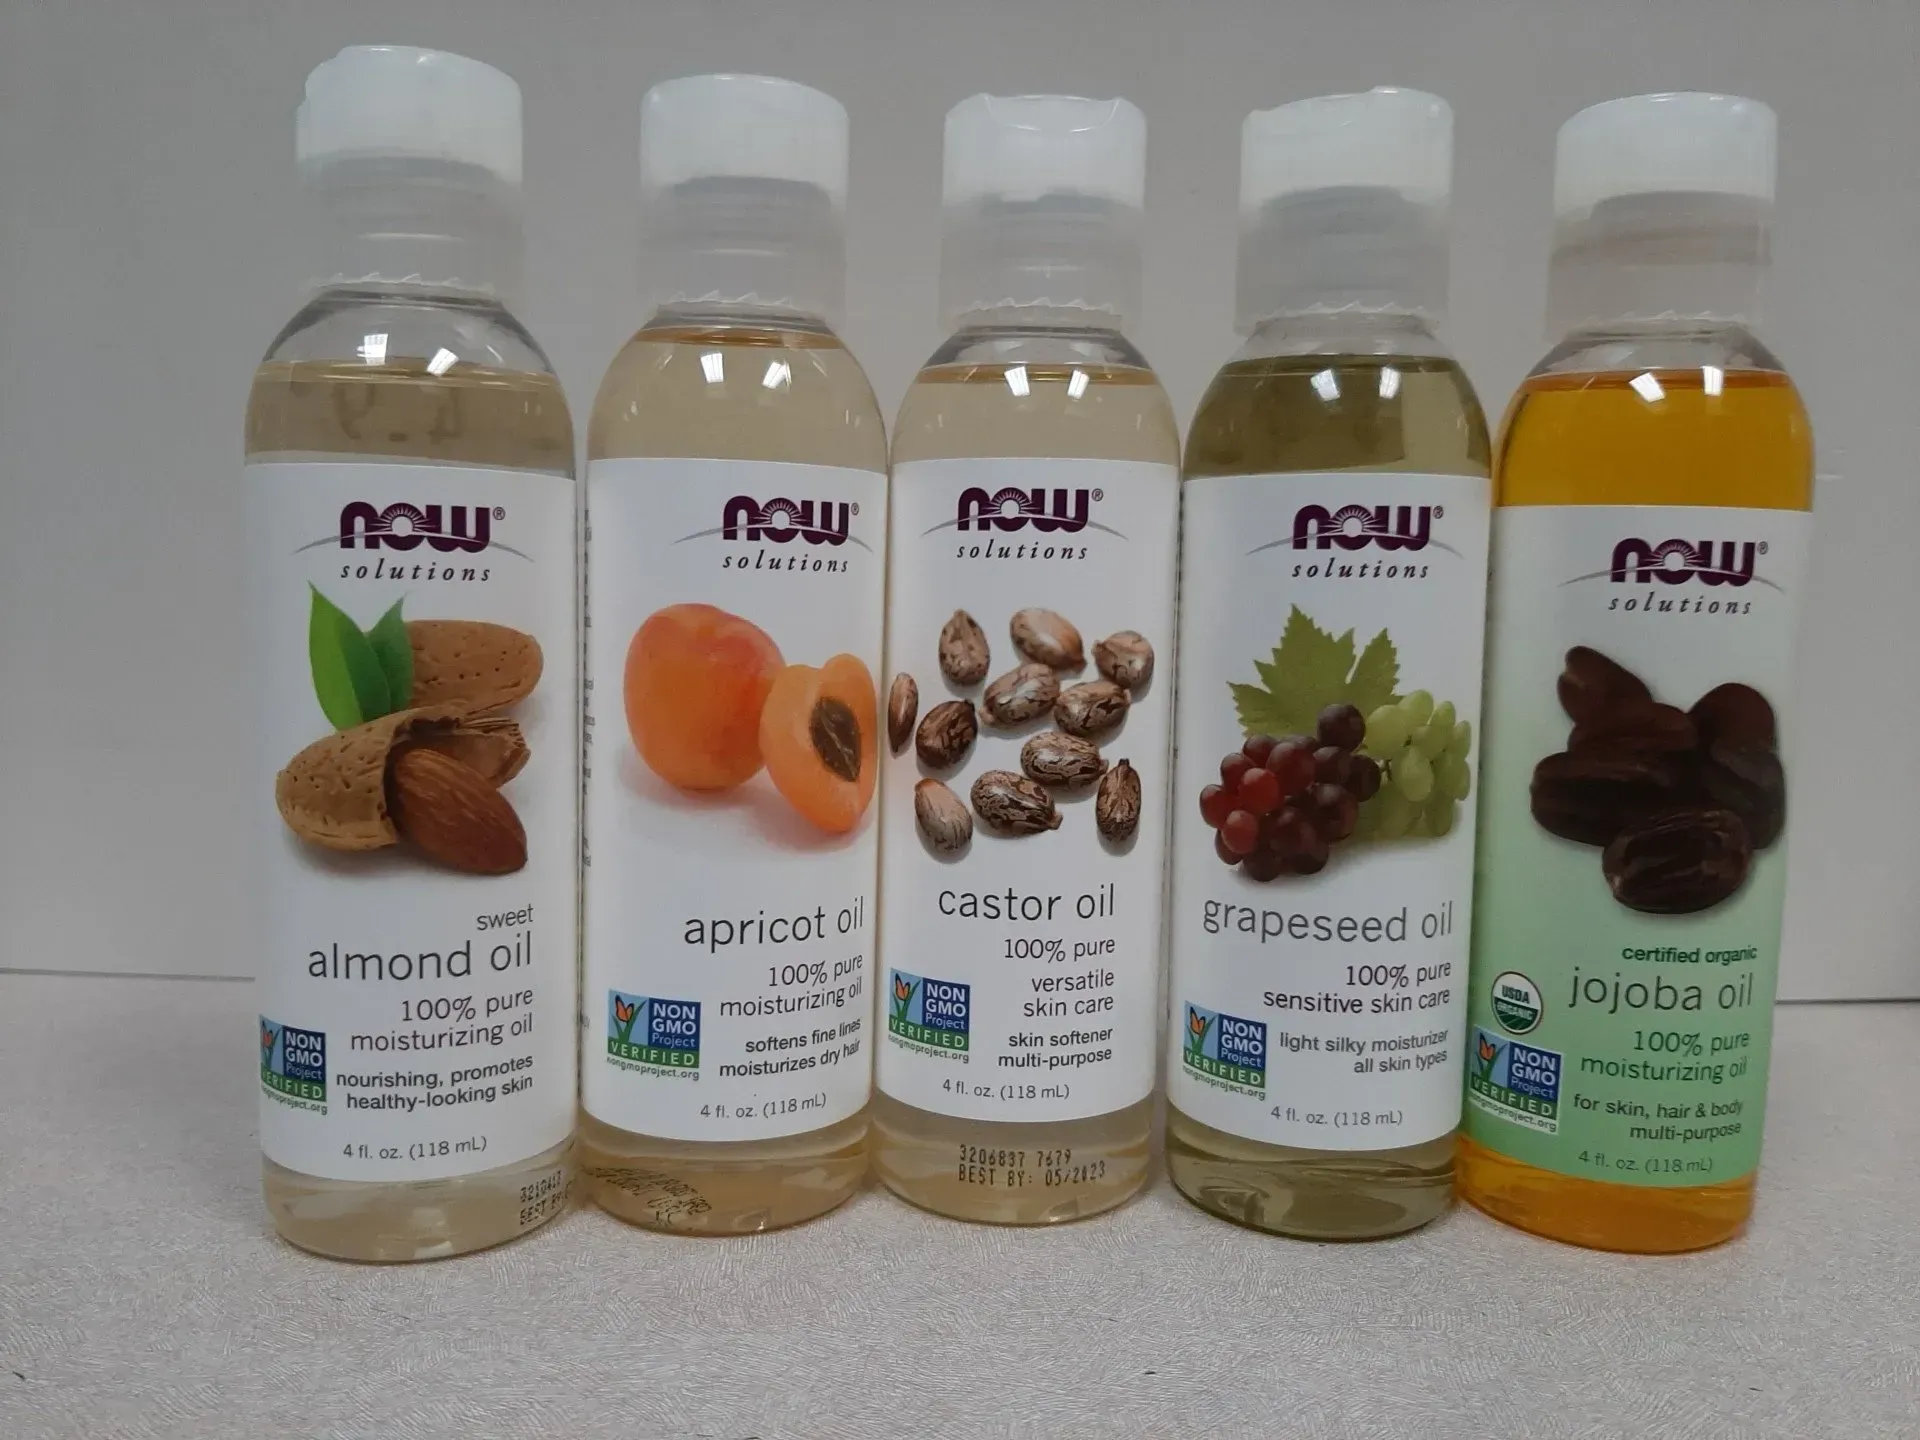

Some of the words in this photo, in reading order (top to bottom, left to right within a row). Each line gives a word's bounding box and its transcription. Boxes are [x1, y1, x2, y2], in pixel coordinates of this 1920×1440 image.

[957, 539, 1087, 559] solutions
[341, 559, 490, 581] solutions
[723, 550, 848, 572] solutions
[1292, 557, 1428, 578] solutions
[1608, 591, 1751, 614] solutions
[939, 888, 1061, 920] castor
[1077, 884, 1114, 917] oil
[477, 904, 533, 930] sweet
[685, 906, 825, 953] apricot
[837, 896, 863, 934] oil
[1204, 900, 1407, 943] grapeseed
[1422, 901, 1452, 939] oil
[309, 941, 471, 980] almond
[491, 931, 532, 971] oil
[1004, 938, 1066, 963] 100%
[1074, 937, 1115, 962] pure
[1622, 947, 1699, 962] certified
[1706, 946, 1757, 965] organic
[769, 961, 827, 987] 100%
[834, 954, 862, 981] pure
[1032, 970, 1114, 992] versatile
[1346, 964, 1409, 989] 100%
[1417, 962, 1451, 986] pure
[720, 988, 844, 1017] moisturizing
[849, 977, 862, 999] oil
[927, 983, 965, 1002] NON
[1263, 991, 1362, 1014] sensitive
[1371, 992, 1411, 1013] skin
[1419, 989, 1450, 1009] care
[1502, 985, 1530, 1004] USDA
[1569, 967, 1701, 1014] jojoba
[1718, 972, 1752, 1010] oil
[402, 996, 476, 1021] 100%
[487, 989, 533, 1017] pure
[654, 1003, 695, 1020] NON
[926, 1000, 966, 1017] GMO
[1024, 999, 1066, 1018] skin
[1074, 995, 1114, 1014] care
[1496, 1002, 1534, 1020] ORGANIC
[351, 1024, 503, 1051] moisturizing
[511, 1014, 533, 1036] oil
[653, 1018, 696, 1035] GMO
[891, 1018, 964, 1047] VERIFIED
[926, 1013, 964, 1030] Project
[1222, 1019, 1262, 1040] NON
[285, 1032, 322, 1050] NON
[652, 1033, 695, 1047] Project
[746, 1034, 807, 1053] softens
[812, 1028, 836, 1045] fine
[839, 1018, 860, 1037] lines
[1009, 1032, 1043, 1047] skin
[1050, 1027, 1113, 1046] softener
[1221, 1036, 1262, 1055] GMO
[1280, 1032, 1319, 1052] light
[1325, 1035, 1366, 1055] silky
[1372, 1030, 1448, 1052] moisturizer
[1634, 1030, 1701, 1057] 100%
[1711, 1031, 1749, 1055] pure
[286, 1048, 322, 1067] GMO
[610, 1042, 695, 1065] VERIFIED
[720, 1056, 815, 1077] moisturizes
[820, 1050, 840, 1065] dry
[843, 1039, 860, 1059] hair
[998, 1048, 1112, 1070] multi-purpose
[1221, 1049, 1261, 1067] Project
[1354, 1059, 1373, 1073] all
[1379, 1058, 1411, 1072] skin
[1416, 1050, 1447, 1070] types
[1514, 1048, 1555, 1071] NON
[286, 1063, 322, 1079] Project
[337, 1069, 444, 1088] nourishing,
[451, 1055, 533, 1086] promotes
[1185, 1051, 1260, 1085] VERIFIED
[1512, 1063, 1555, 1085] GMO
[1581, 1056, 1723, 1084] moisturizing
[1730, 1058, 1746, 1078] oil
[347, 1087, 495, 1112] healthy-looking
[502, 1075, 533, 1095] skin
[943, 1079, 951, 1091] 4
[956, 1081, 968, 1095] fl.
[974, 1085, 995, 1097] oz.
[1001, 1085, 1036, 1100] (118
[1042, 1084, 1069, 1099] mL)
[1473, 1077, 1552, 1115] VERIFIED
[1511, 1077, 1554, 1098] Project
[700, 1105, 710, 1117] 4
[716, 1105, 729, 1119] fl.
[736, 1106, 757, 1119] oz.
[763, 1101, 797, 1119] (118
[801, 1093, 826, 1110] mL)
[1271, 1107, 1281, 1118] 4
[1286, 1107, 1299, 1122] fl.
[1306, 1111, 1328, 1125] oz.
[1334, 1112, 1370, 1128] (118
[1375, 1110, 1402, 1126] mL)
[1574, 1094, 1599, 1110] for
[1606, 1099, 1649, 1119] skin,
[1657, 1102, 1690, 1118] hair
[1695, 1103, 1706, 1117] &
[1711, 1098, 1742, 1117] body
[1630, 1122, 1741, 1144] multi-purpose
[343, 1145, 353, 1157] 4
[359, 1144, 372, 1158] fl.
[380, 1147, 403, 1159] oz.
[410, 1141, 450, 1160] (118
[456, 1137, 487, 1153] mL)
[960, 1144, 1025, 1167] 3206837
[959, 1164, 996, 1185] BEST
[1008, 1170, 1032, 1187] BY:
[1045, 1160, 1105, 1186] 05/2023
[1579, 1151, 1590, 1163] 4
[1595, 1152, 1608, 1168] fl.
[1616, 1158, 1637, 1171] oz.
[1645, 1158, 1683, 1174] (118
[1686, 1157, 1713, 1172] mL)
